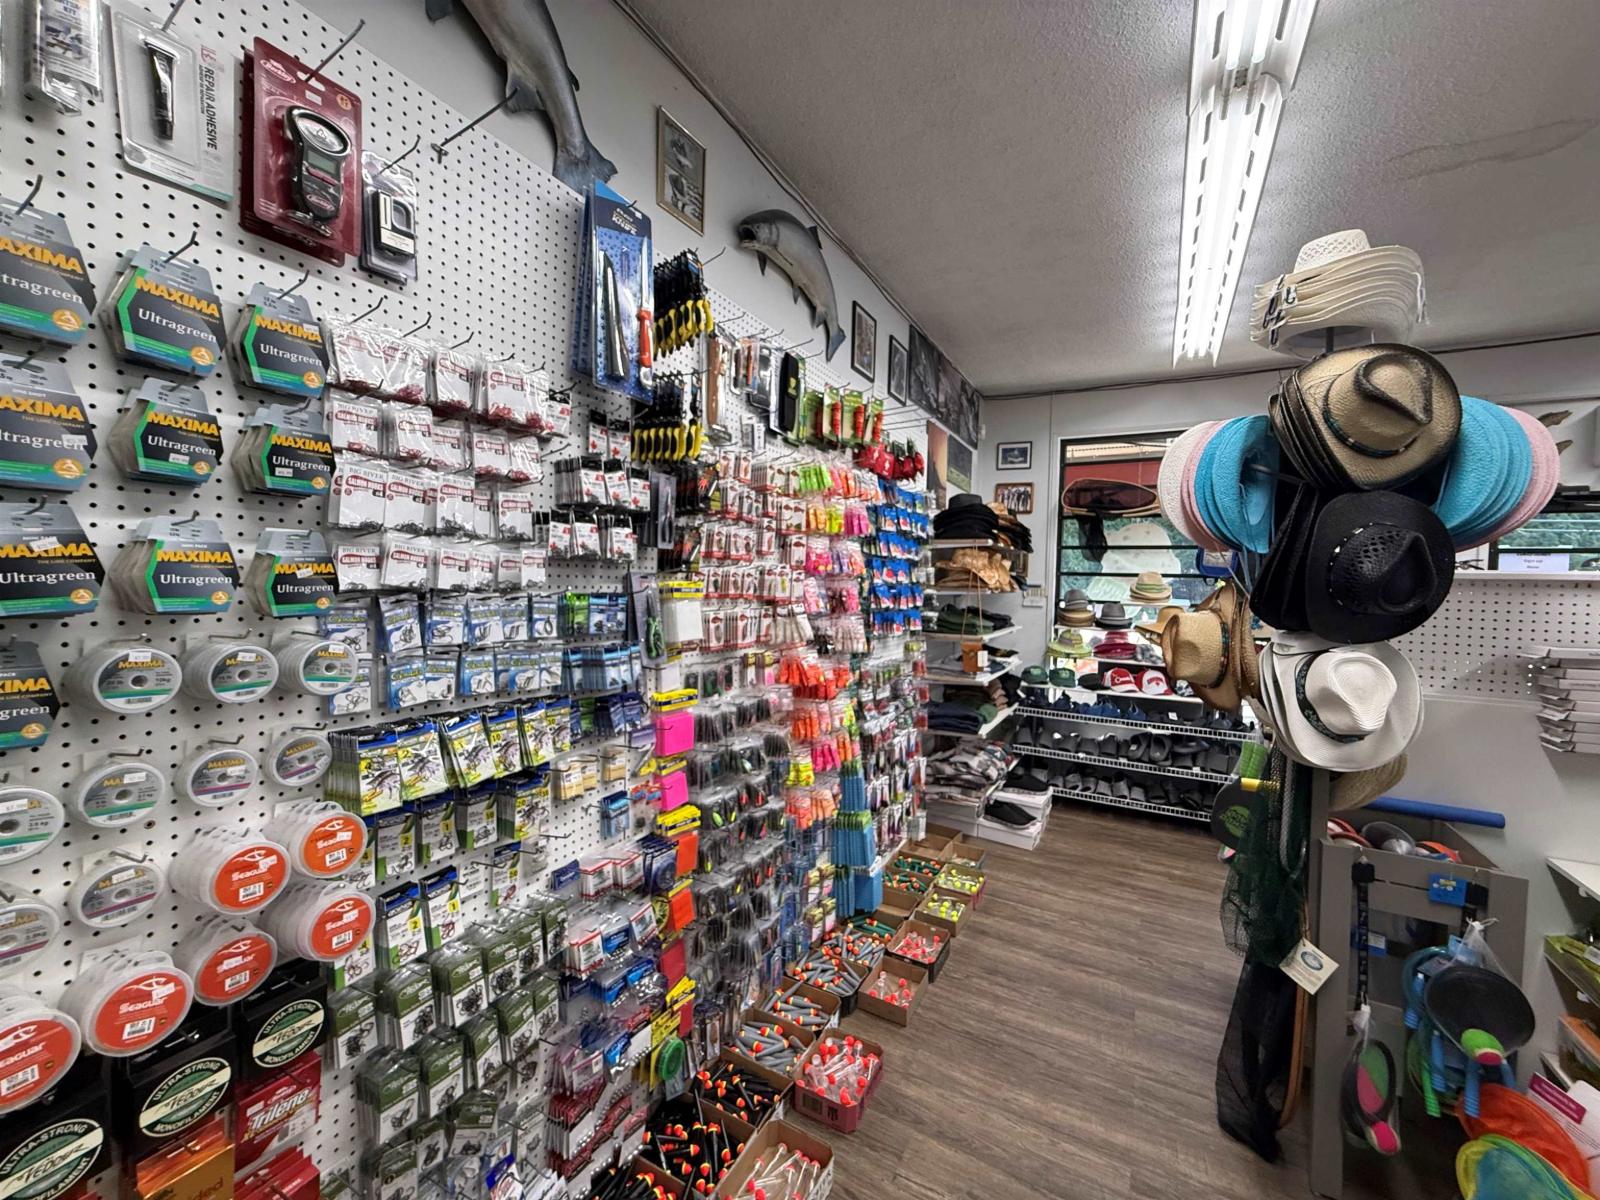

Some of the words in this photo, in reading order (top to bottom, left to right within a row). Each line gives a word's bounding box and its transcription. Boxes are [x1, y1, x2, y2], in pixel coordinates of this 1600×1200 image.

[204, 66, 215, 101] REPAIR
[205, 102, 217, 150] ADHESIVE
[135, 277, 220, 318] MAXIMA
[138, 307, 217, 343] Ultragreen
[255, 315, 323, 343] MAXIMA
[260, 343, 322, 367] Ultragreen
[147, 411, 220, 436] MAXIMA
[147, 434, 217, 457] Ultragreen
[271, 434, 332, 453] MAXIMA
[272, 455, 331, 472] Ultragreen
[0, 543, 94, 559] MAXIMA
[156, 550, 233, 563] MAXIMA
[0, 571, 96, 585] Ultragreen
[274, 563, 335, 575] MAMA
[160, 573, 233, 586] Ultragreen
[277, 584, 334, 594] Ultragreen
[226, 655, 263, 667] MAA
[0, 705, 50, 720] green
[491, 734, 501, 742] 10
[285, 740, 318, 757] MAXIMA
[207, 758, 246, 769] MAXIMA
[412, 920, 418, 930] 2
[263, 1003, 317, 1034] ULTRA-STRONG
[263, 1030, 316, 1063] MONOFILAMENT
[153, 1061, 221, 1101] ULTRA-STRONG
[153, 1091, 220, 1132] MONOFILAMENT
[0, 1124, 89, 1175] ULTRA-STRONG
